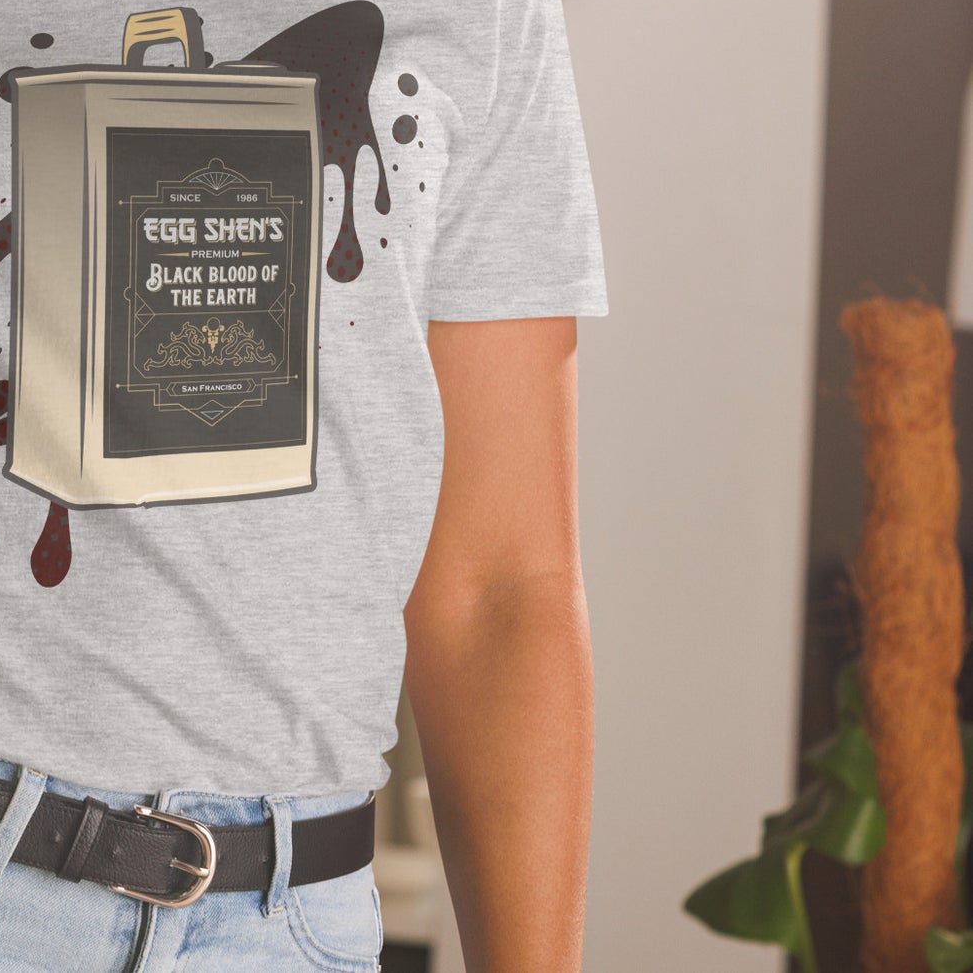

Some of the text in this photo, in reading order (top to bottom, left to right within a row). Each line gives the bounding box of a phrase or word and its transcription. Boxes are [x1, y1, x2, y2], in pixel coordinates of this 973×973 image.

[170, 193, 258, 202] SINCE 1986
[143, 216, 284, 245] EGG SHEN'S
[191, 250, 240, 259] PREMIUM
[208, 265, 257, 284] BLOOD
[261, 264, 280, 283] OF
[170, 287, 257, 307] THE EARTH
